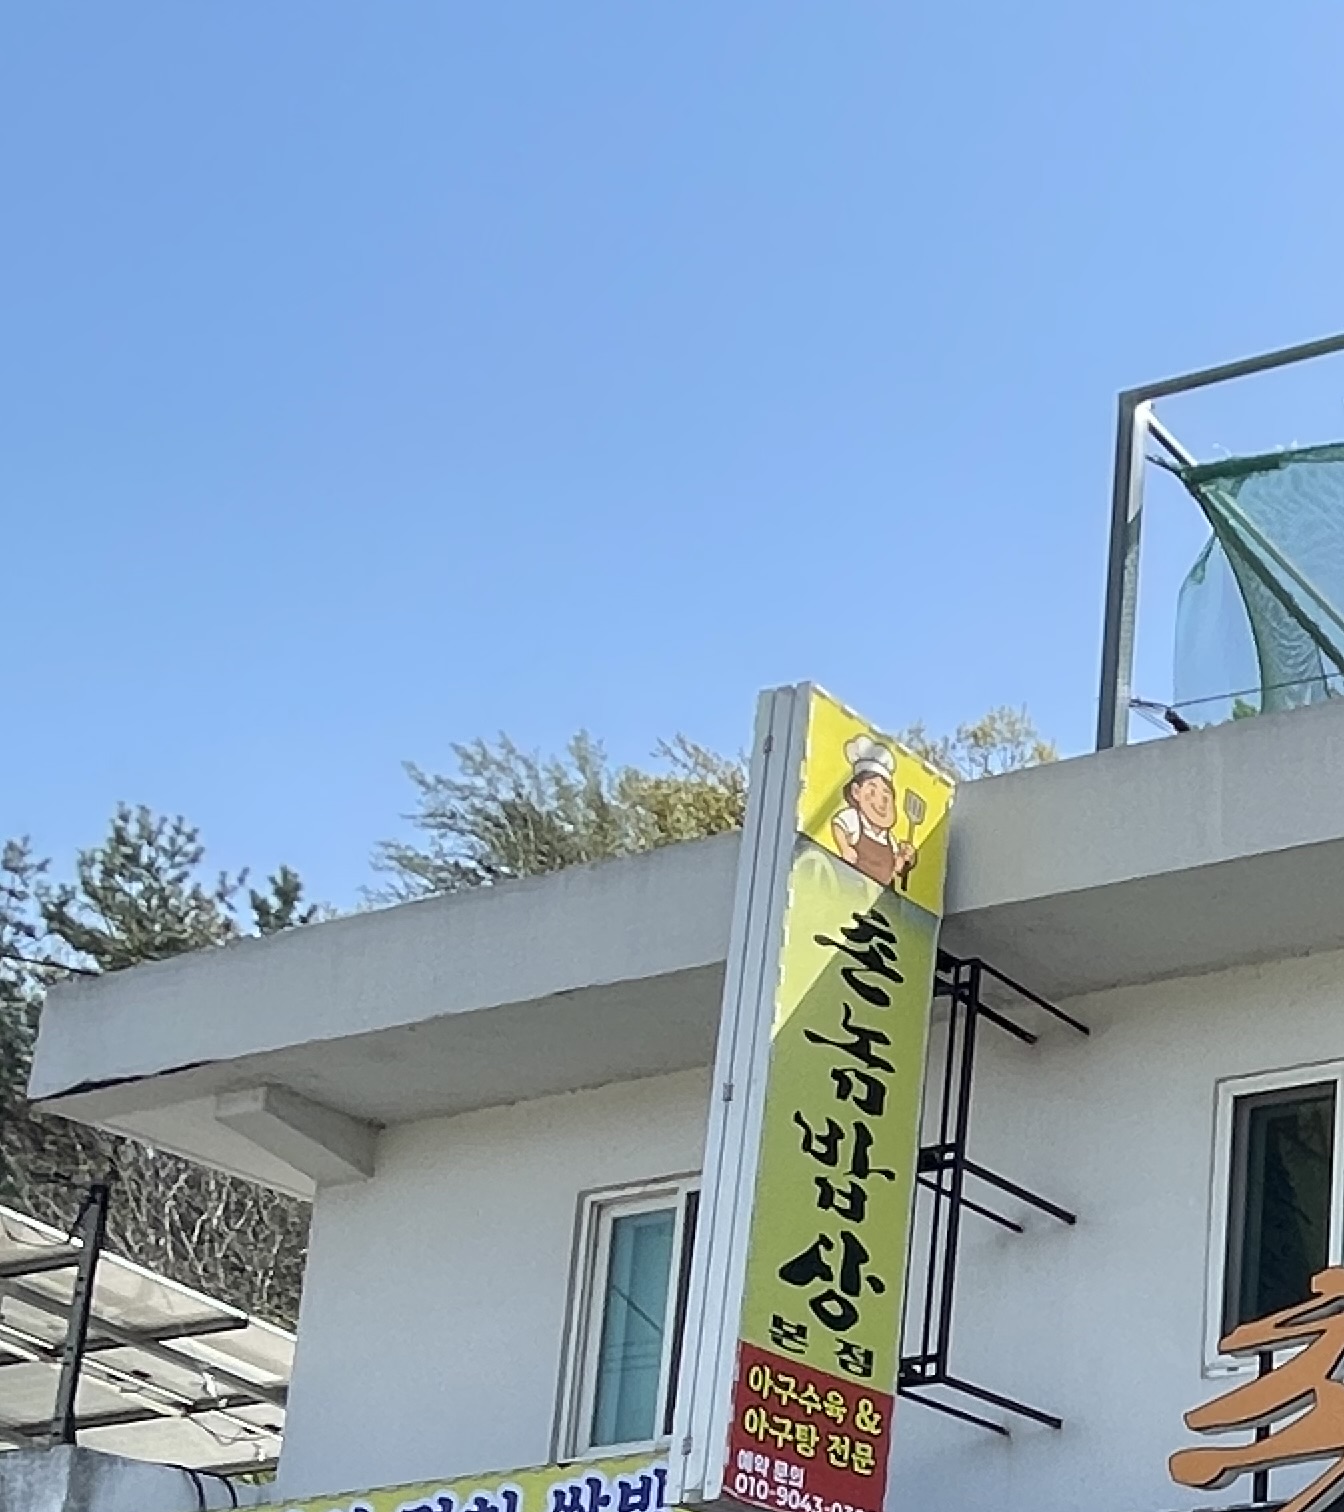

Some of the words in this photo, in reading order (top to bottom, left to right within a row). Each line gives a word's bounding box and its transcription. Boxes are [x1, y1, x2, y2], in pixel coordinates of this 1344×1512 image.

[780, 908, 904, 1332] 촌놈밥상
[749, 1365, 847, 1424] 아구수육
[855, 1398, 882, 1435] &
[744, 1407, 819, 1457] 아구탕
[826, 1434, 876, 1475] 전문
